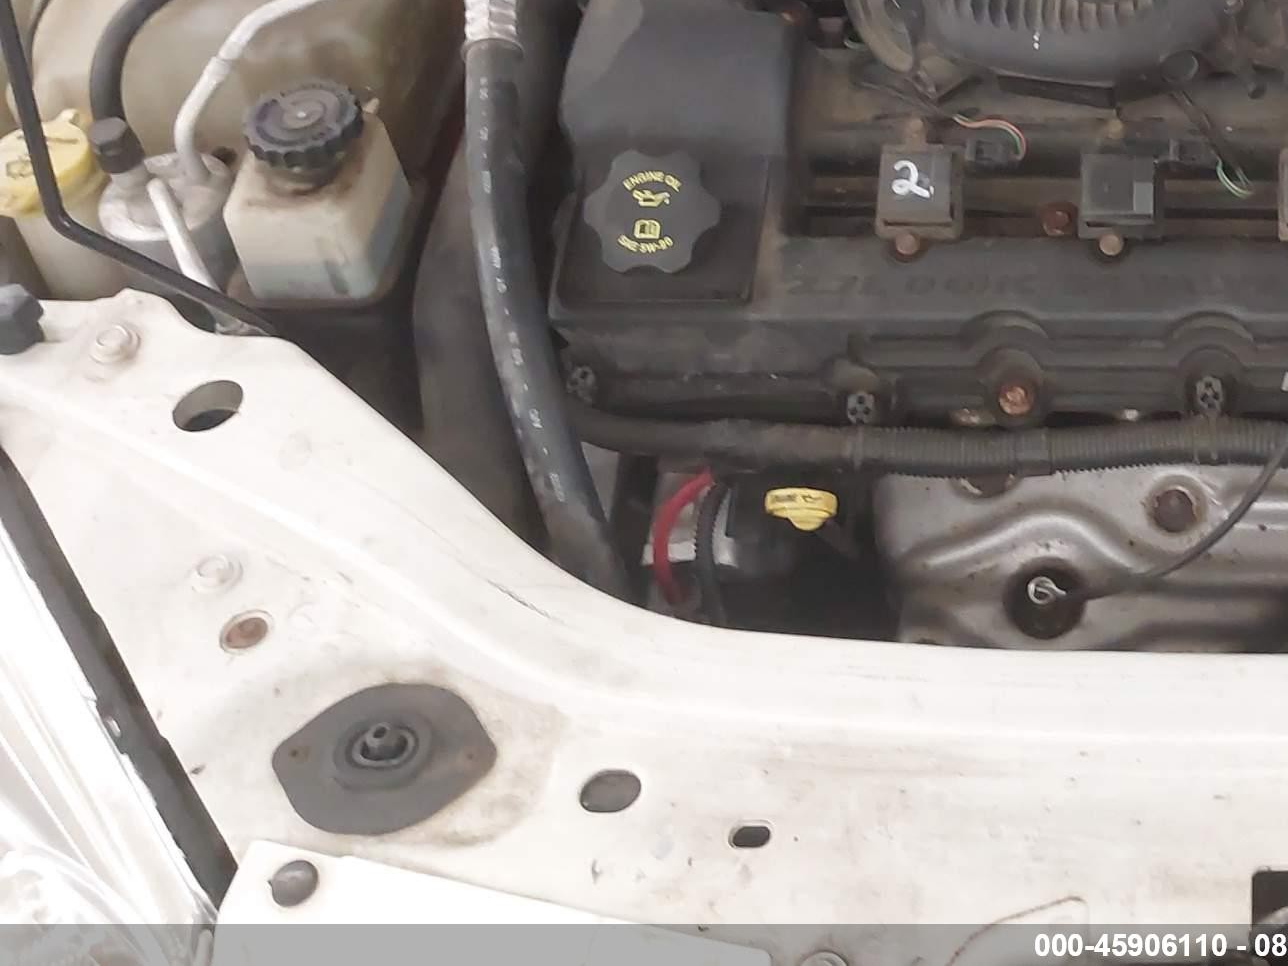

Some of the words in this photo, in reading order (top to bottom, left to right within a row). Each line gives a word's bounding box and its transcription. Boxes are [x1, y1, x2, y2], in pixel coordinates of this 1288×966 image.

[622, 171, 665, 191] ENGINE
[665, 175, 682, 192] OIL
[892, 160, 930, 198] 2
